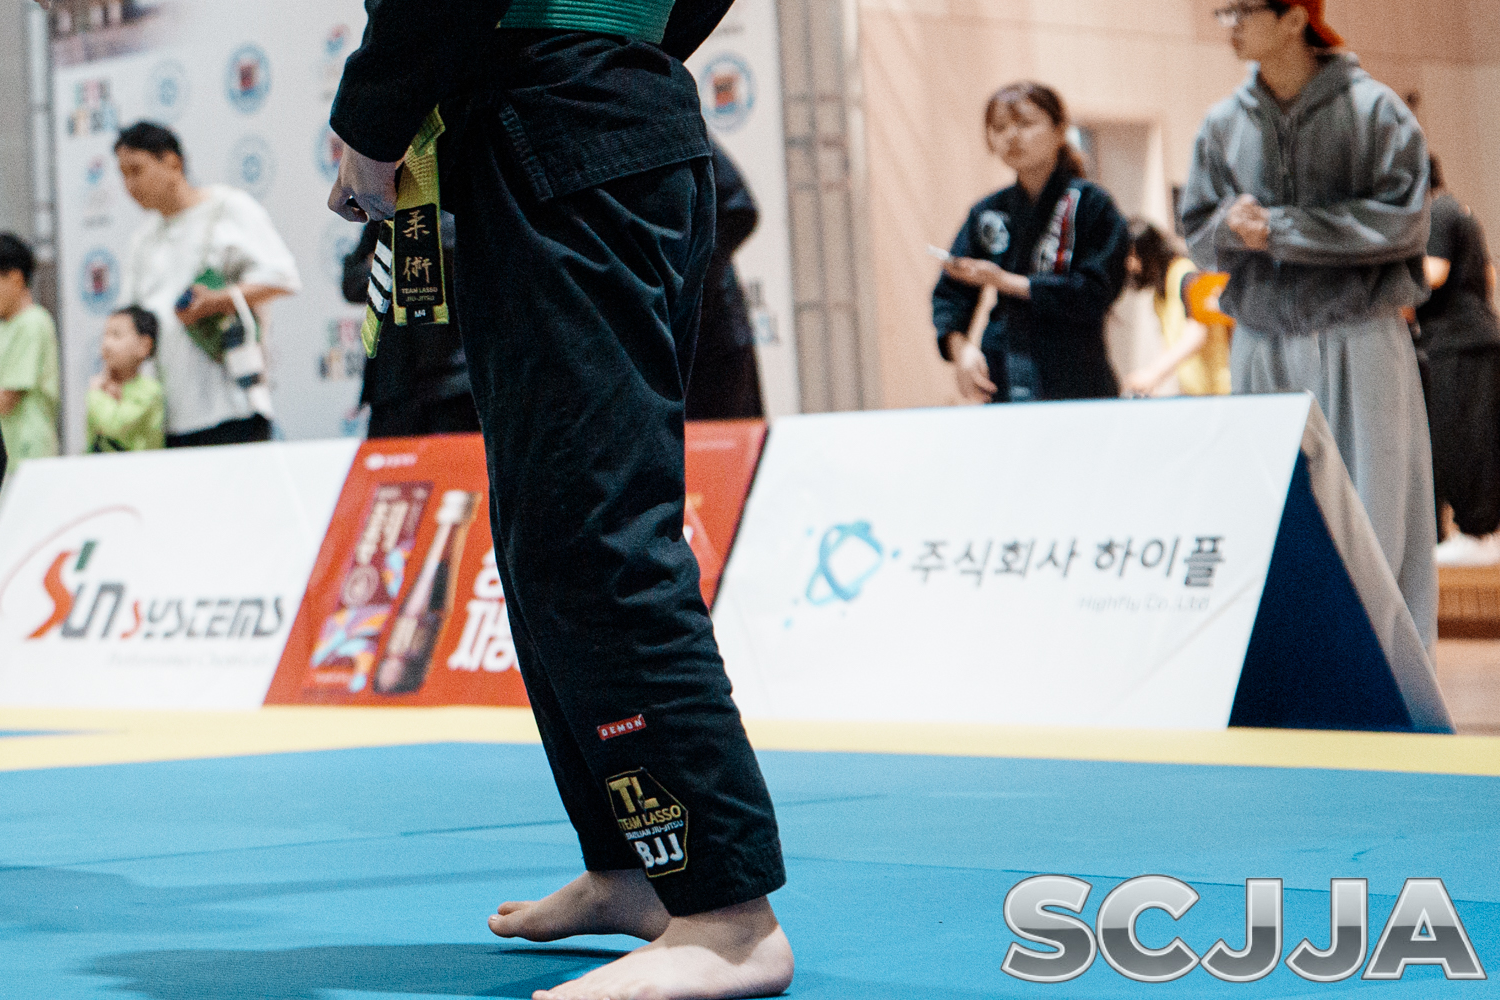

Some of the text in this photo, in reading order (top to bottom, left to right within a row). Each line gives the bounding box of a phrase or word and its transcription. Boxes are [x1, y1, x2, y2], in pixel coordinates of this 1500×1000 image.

[401, 286, 438, 295] TEAM LASSO
[911, 534, 1227, 589] 주식회사 하이플
[601, 719, 642, 737] DEMON
[608, 776, 660, 813] TL
[619, 804, 682, 831] TEAM LASSO
[651, 820, 684, 834] JIU-JITSU
[634, 832, 684, 869] BJJ
